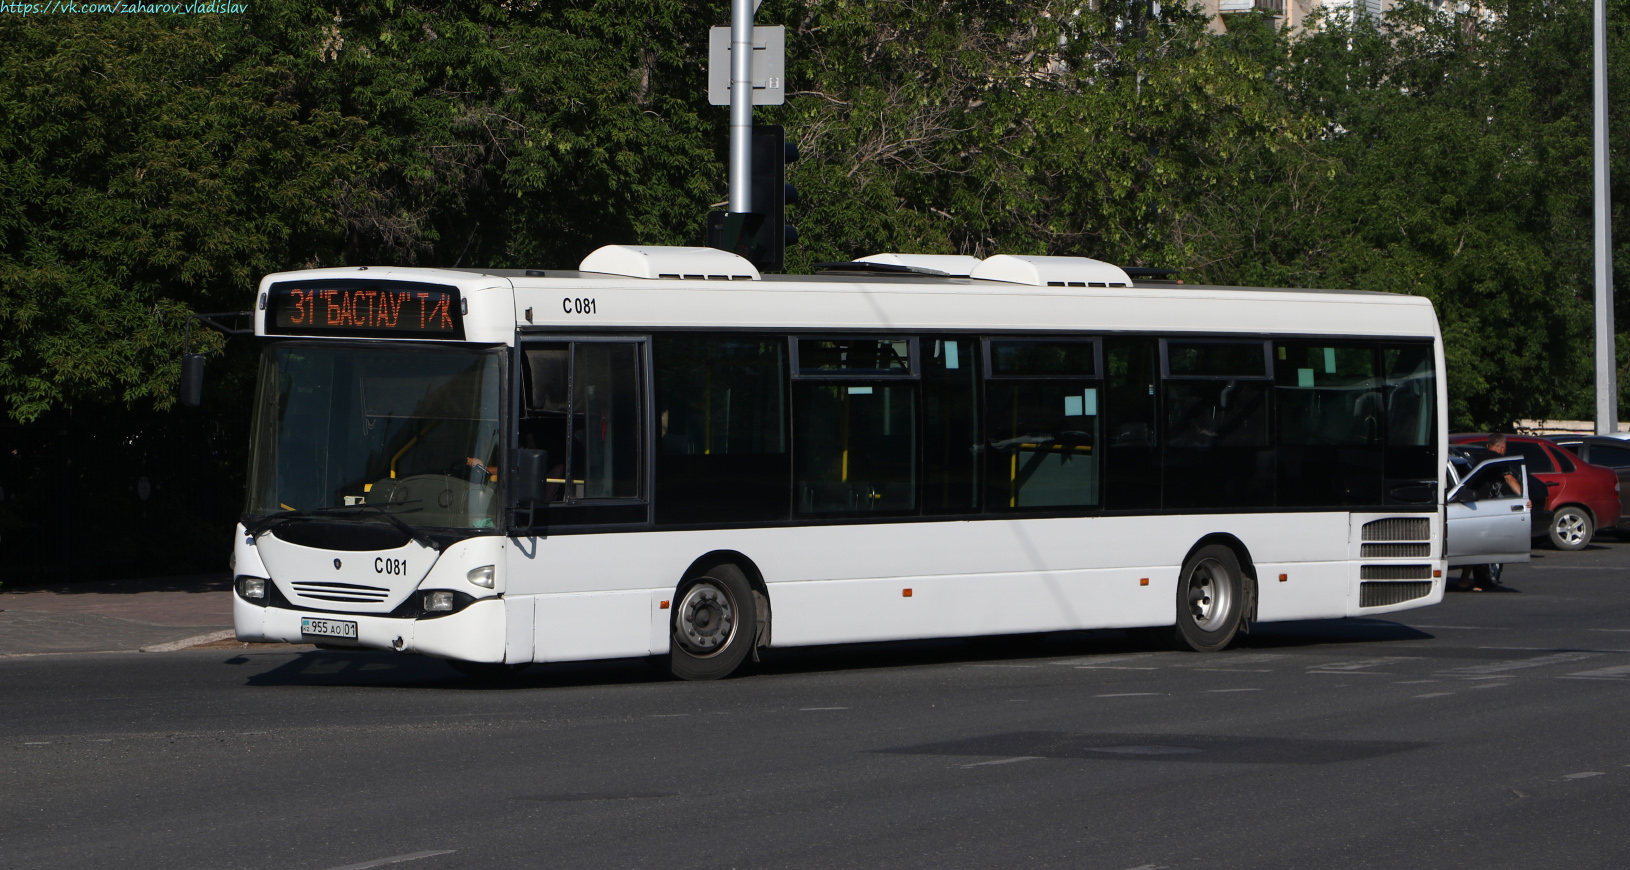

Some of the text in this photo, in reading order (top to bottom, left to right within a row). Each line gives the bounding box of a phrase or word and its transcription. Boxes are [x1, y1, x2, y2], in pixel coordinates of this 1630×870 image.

[290, 289, 315, 325] 31
[319, 289, 411, 328] "БАСТАУ"
[311, 620, 328, 634] 955
[344, 623, 356, 636] 01
